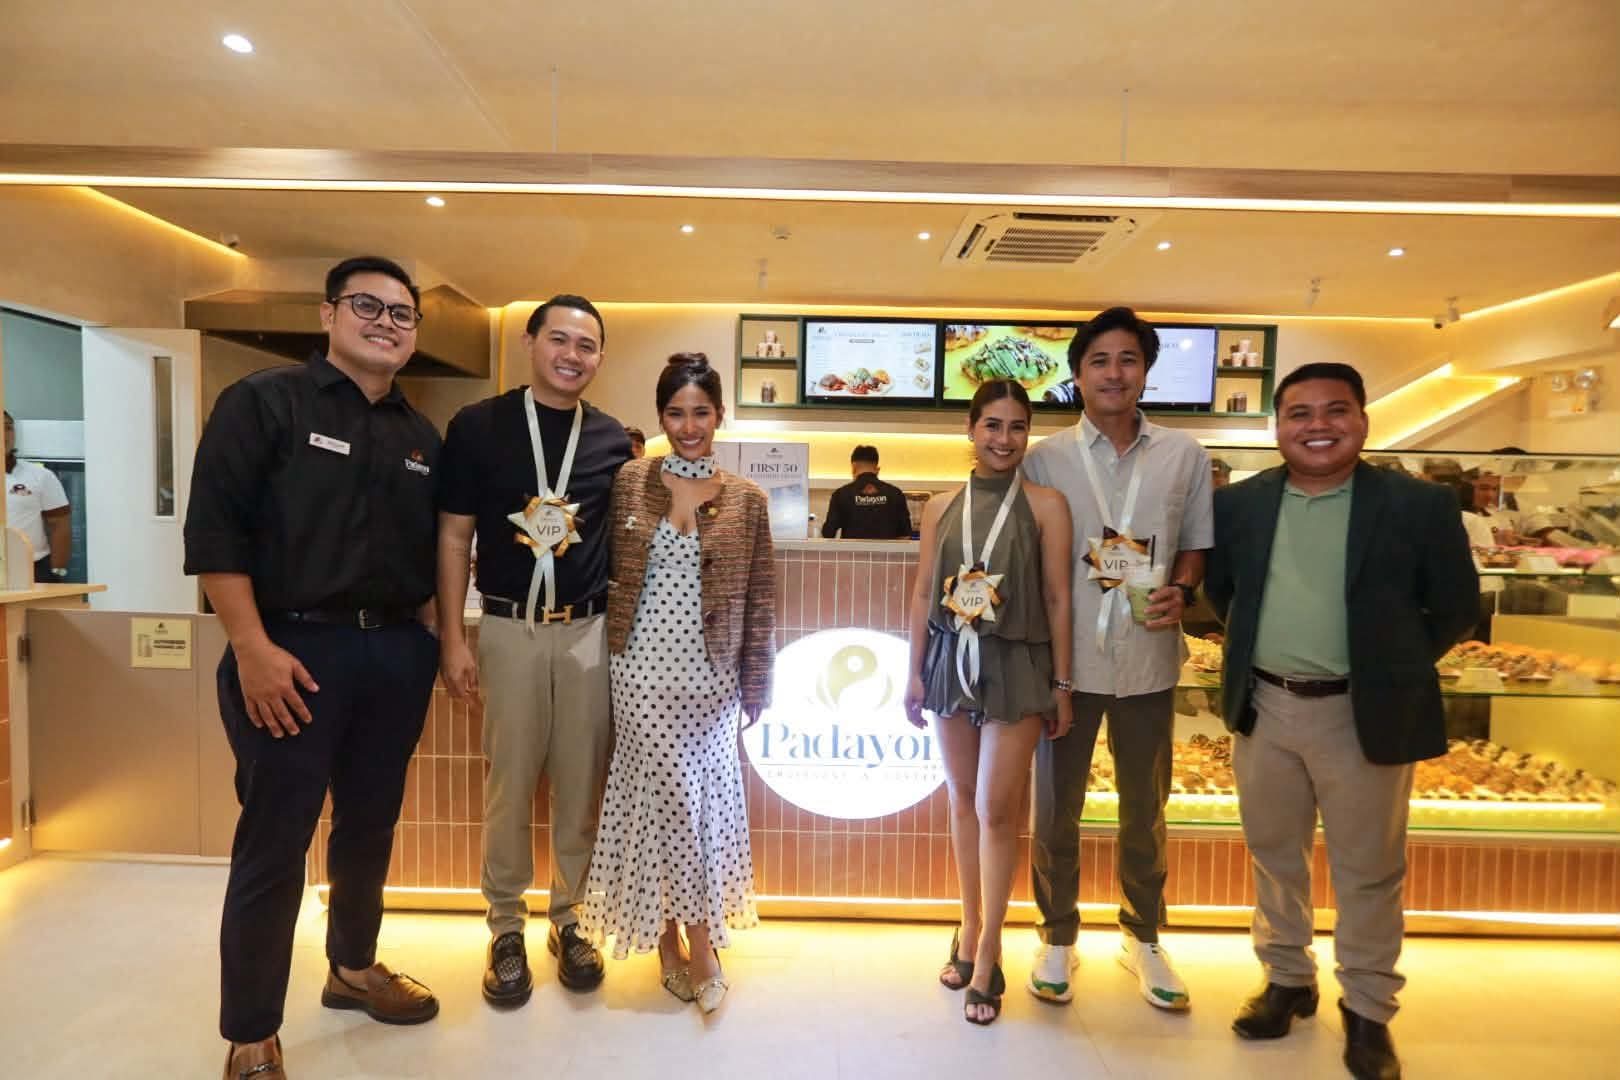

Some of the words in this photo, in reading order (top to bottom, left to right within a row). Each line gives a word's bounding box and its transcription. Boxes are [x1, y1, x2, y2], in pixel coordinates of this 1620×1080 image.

[750, 463, 781, 473] FIRST
[783, 463, 799, 473] 50
[536, 525, 561, 536] VIP
[1104, 559, 1129, 571] VIP
[961, 596, 984, 607] VIP
